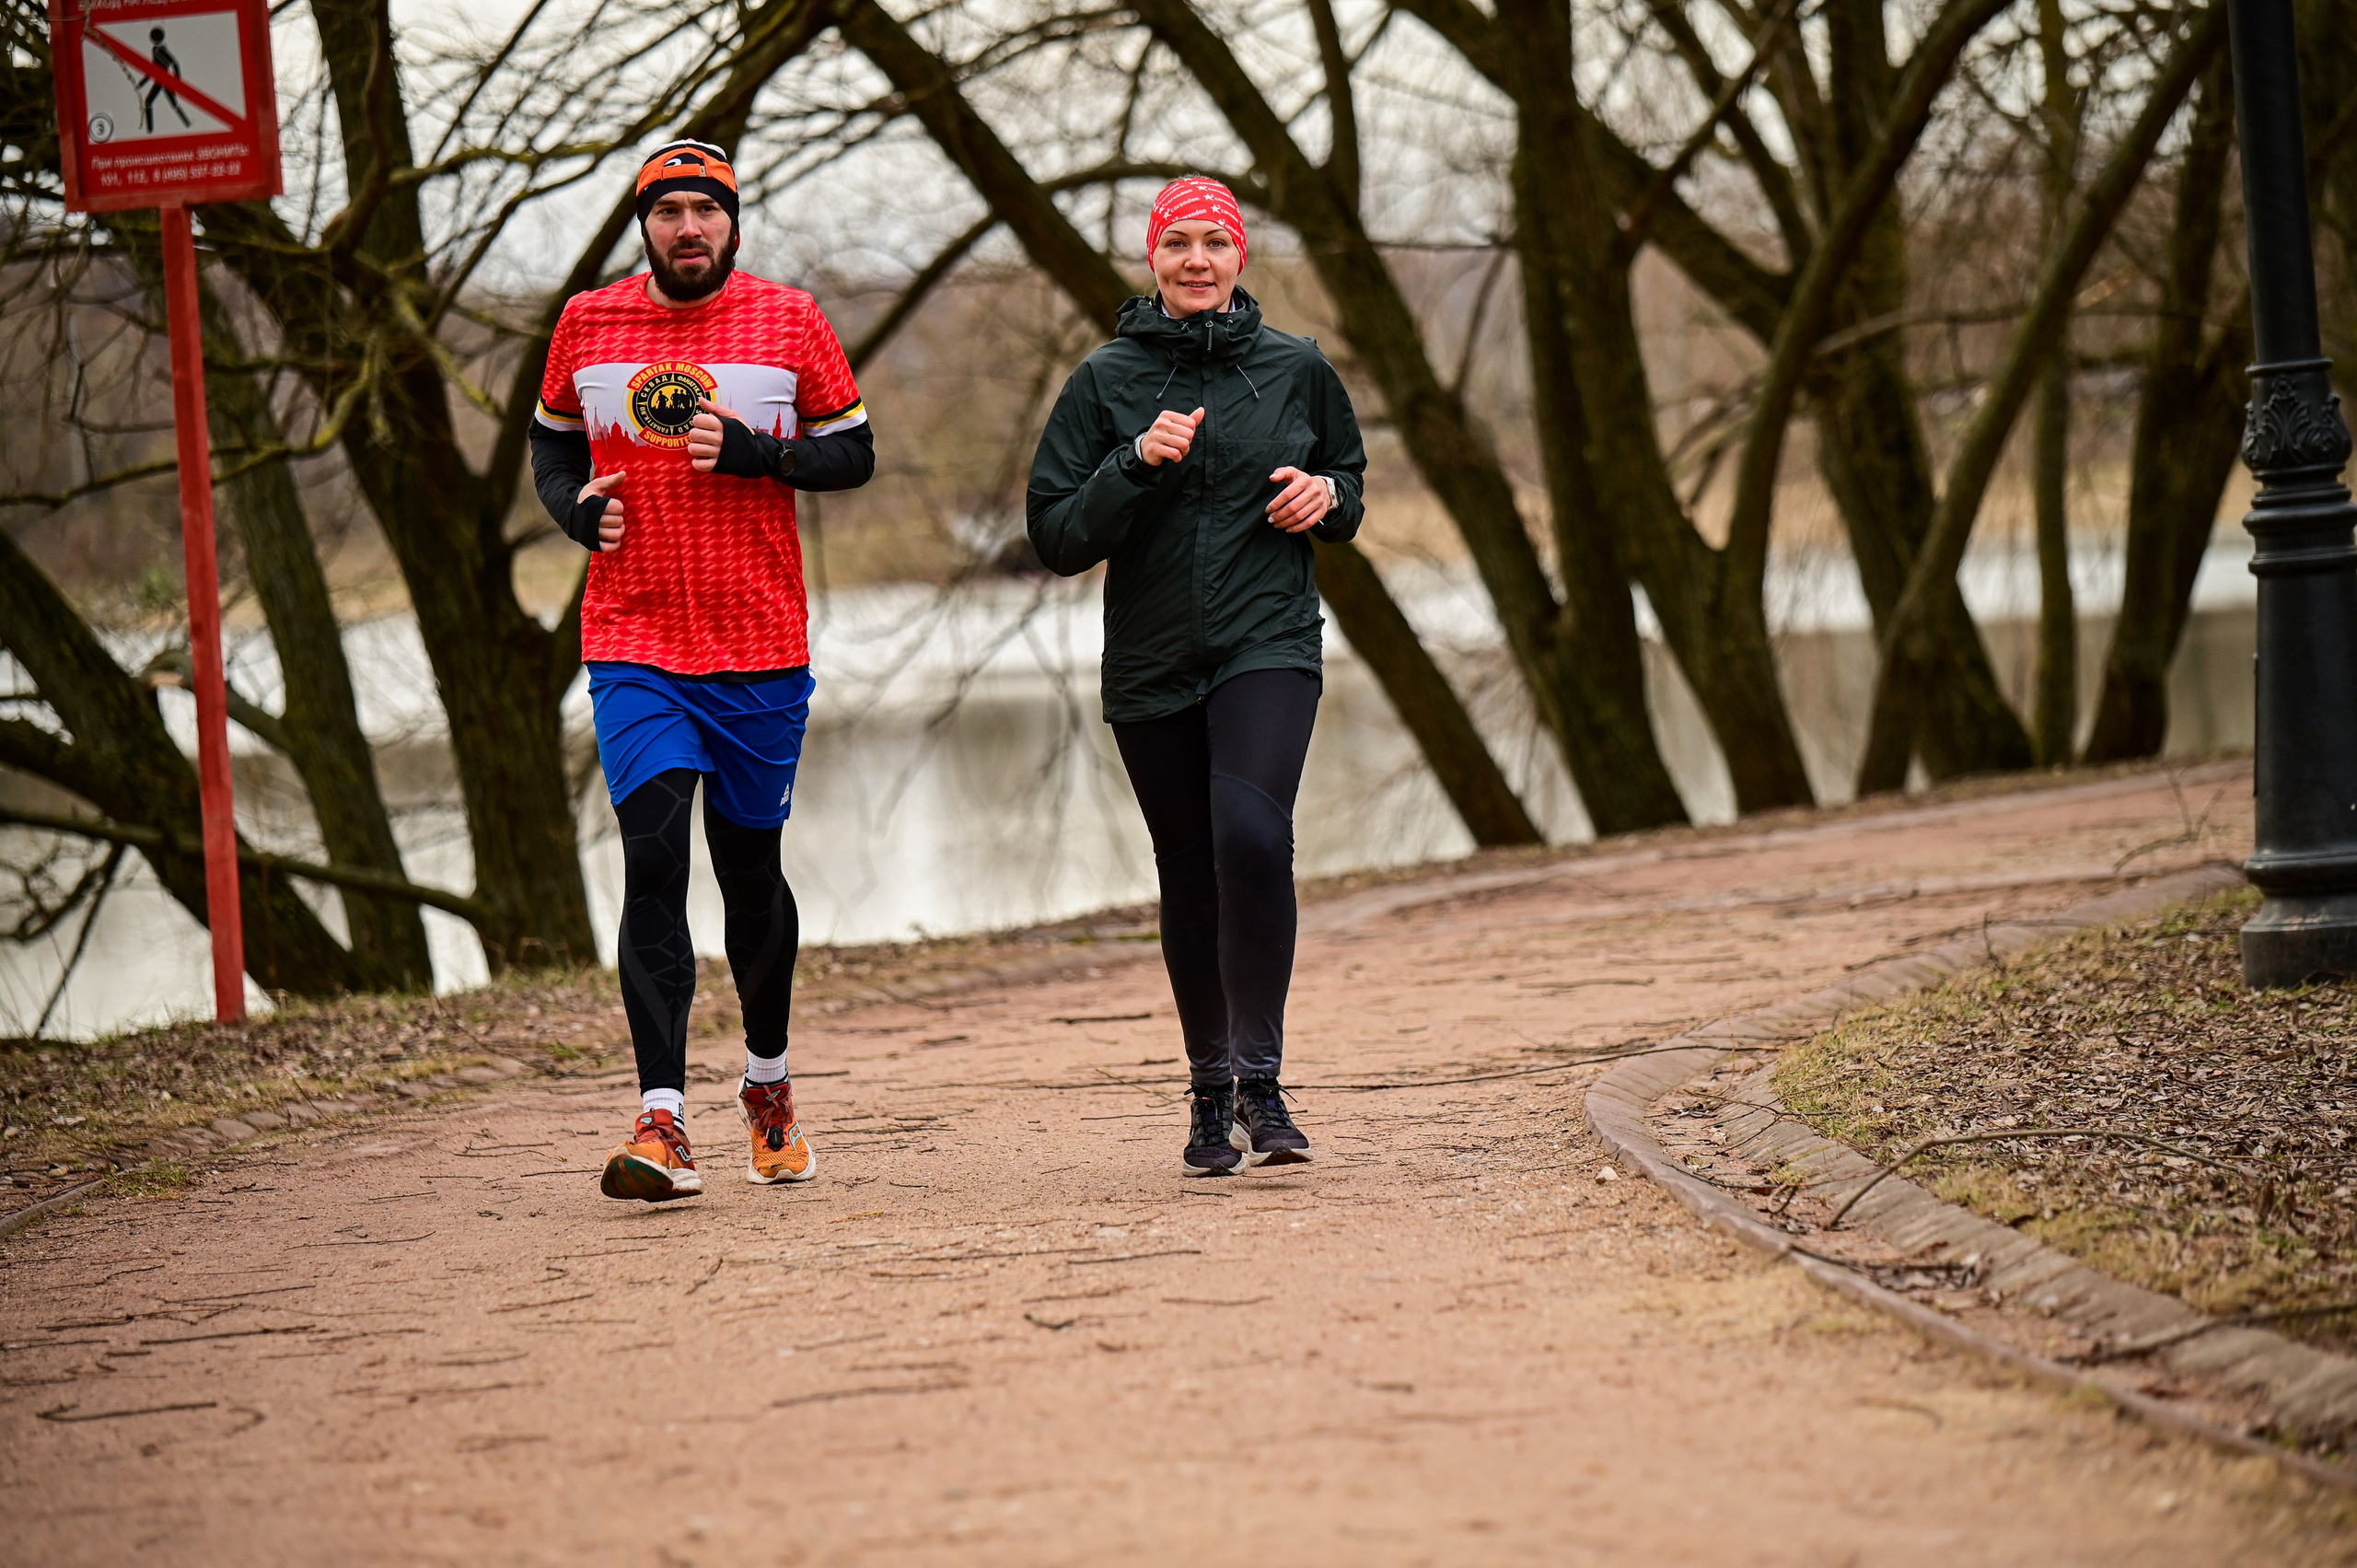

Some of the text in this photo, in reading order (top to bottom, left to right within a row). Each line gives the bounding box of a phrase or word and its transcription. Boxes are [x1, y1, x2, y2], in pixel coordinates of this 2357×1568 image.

[1170, 197, 1200, 213] corendon
[1179, 208, 1207, 220] orendon
[631, 363, 714, 389] SPARTAK MOSCOW
[641, 375, 668, 398] СКВАД
[678, 409, 702, 433] SUAD
[644, 430, 690, 447] SUPPORTE
